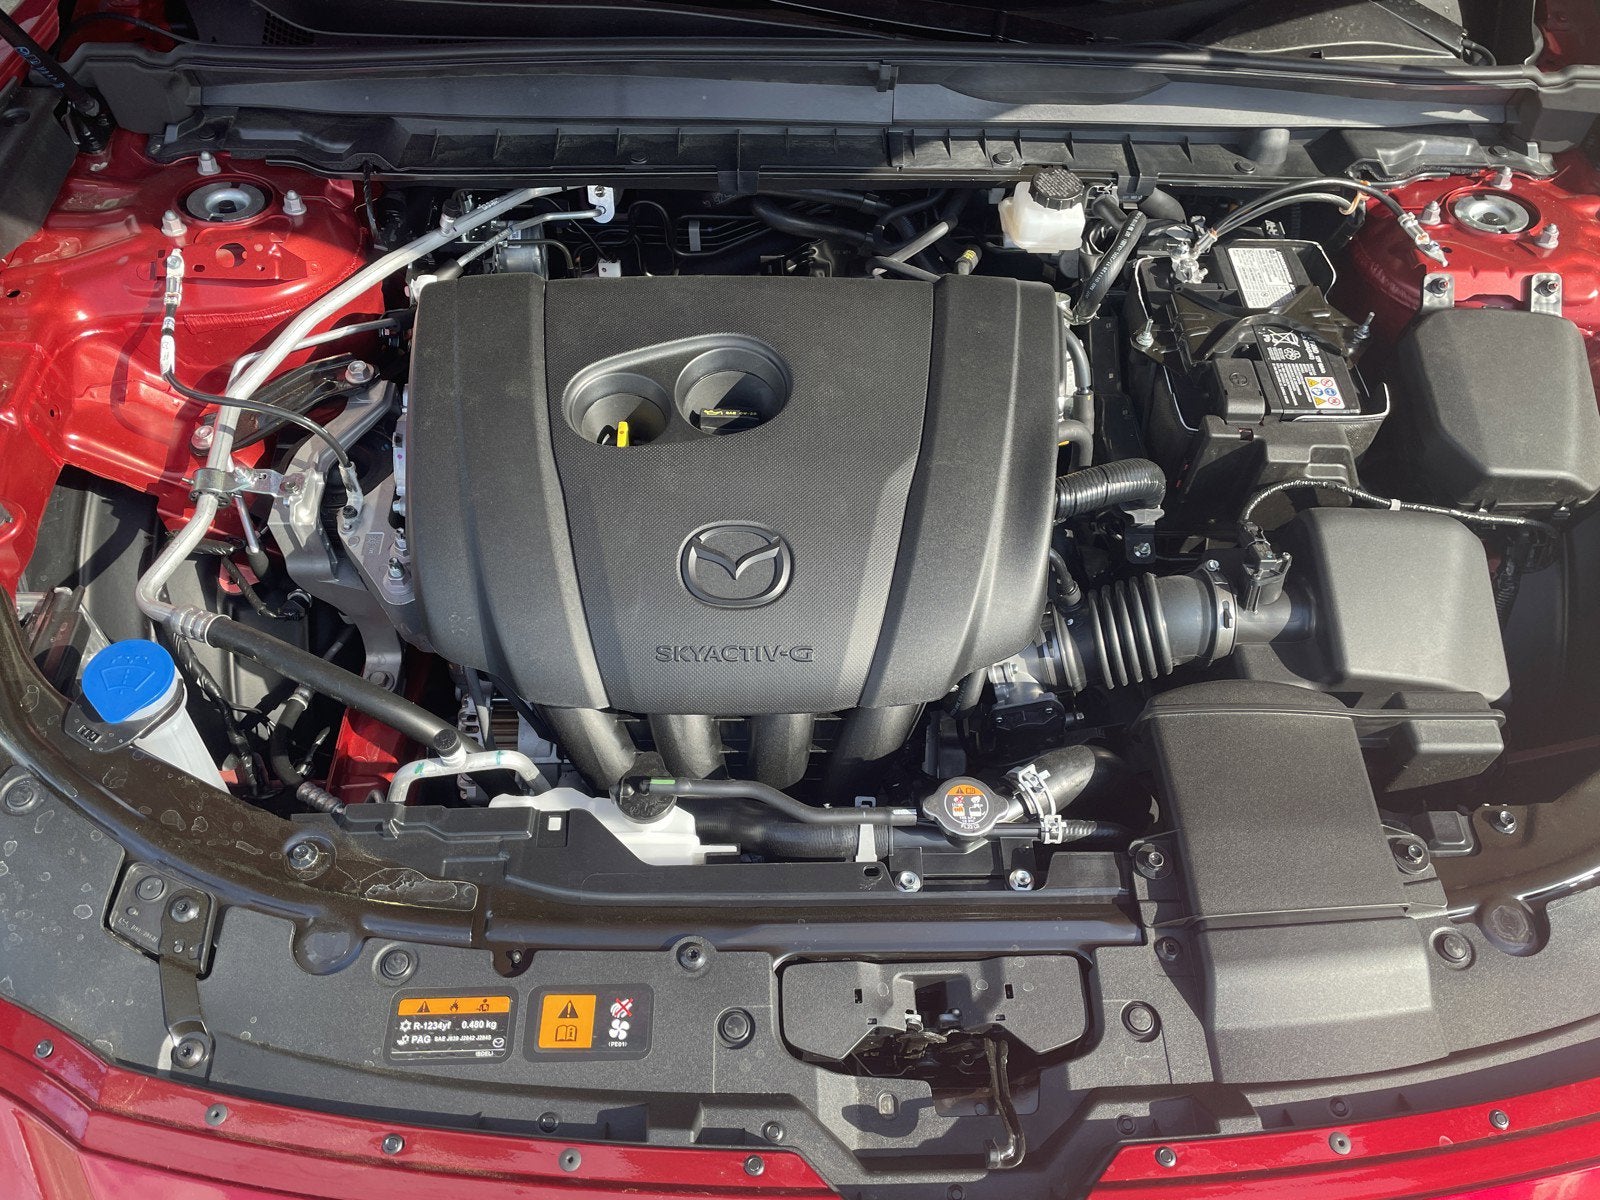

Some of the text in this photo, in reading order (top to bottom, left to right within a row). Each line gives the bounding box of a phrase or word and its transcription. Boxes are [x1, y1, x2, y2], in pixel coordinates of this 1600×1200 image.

[655, 645, 814, 663] SKYACTIV-G
[413, 1021, 452, 1031] R-1234yf
[486, 1020, 498, 1030] kg
[411, 1035, 432, 1044] PAG
